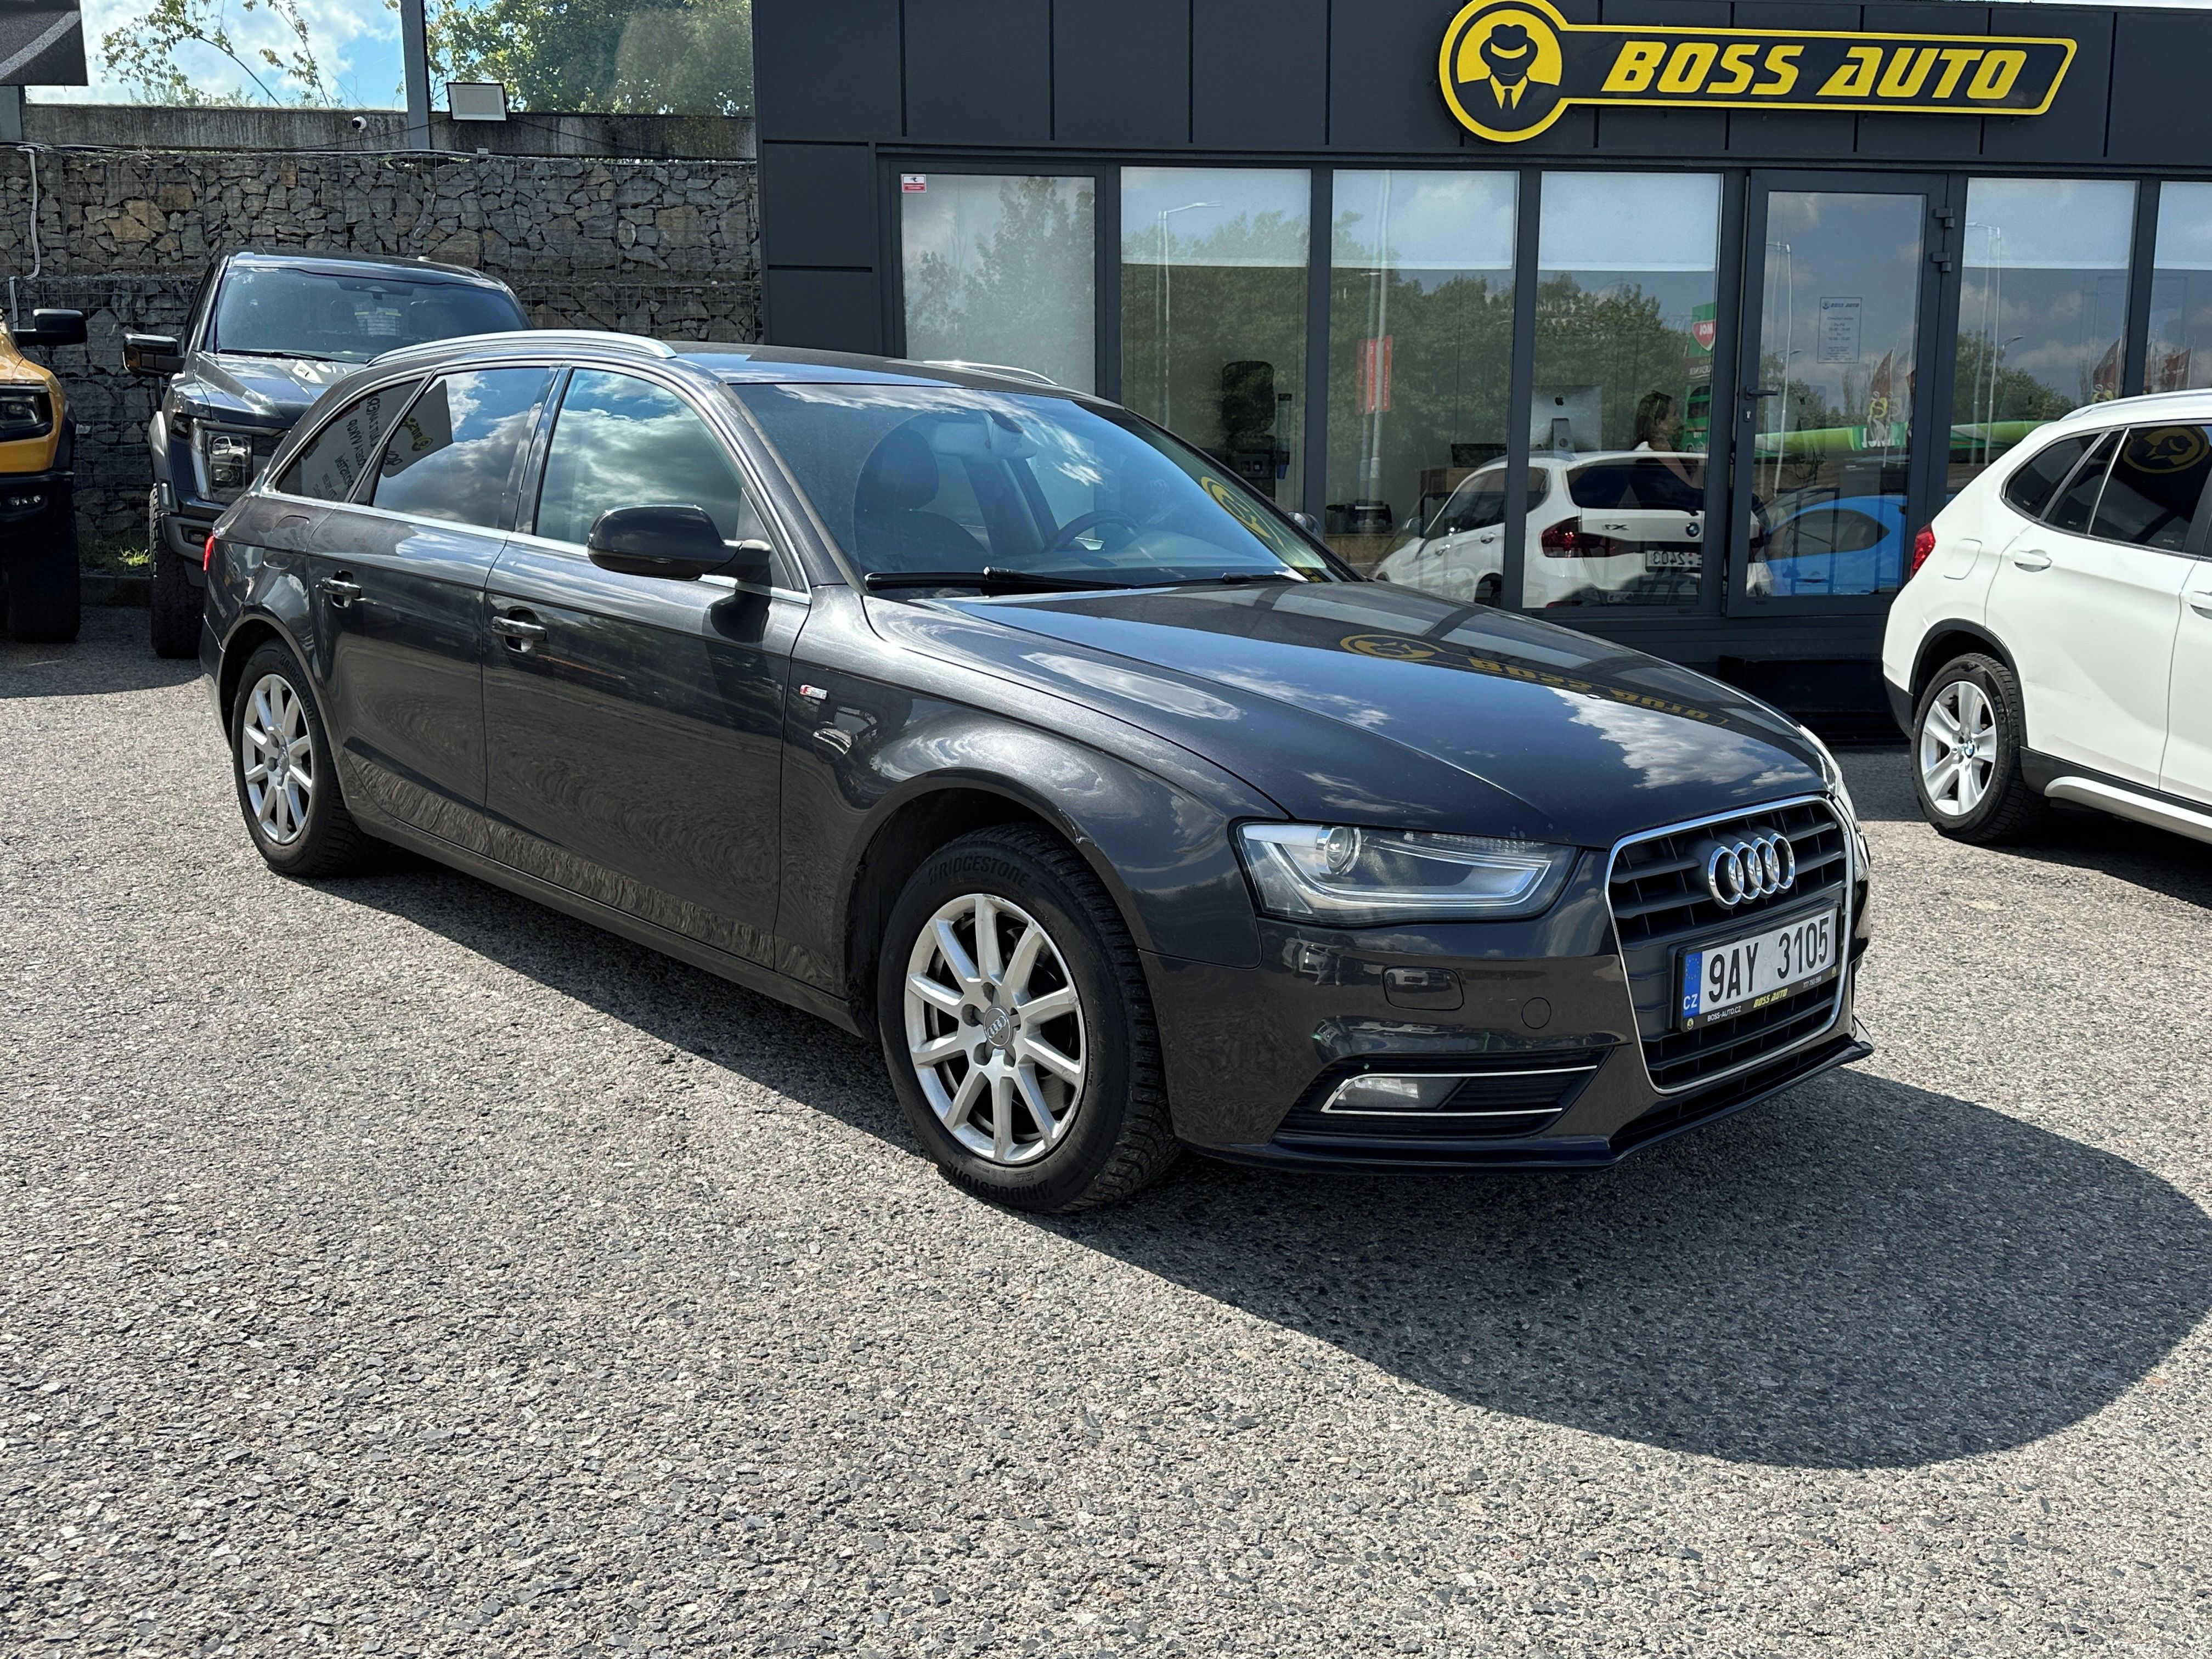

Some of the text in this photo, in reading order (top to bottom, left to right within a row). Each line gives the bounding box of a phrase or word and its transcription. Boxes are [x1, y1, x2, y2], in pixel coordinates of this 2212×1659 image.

[1601, 40, 2028, 100] BOSS AUTO
[928, 855, 1032, 888] BRIDGESTONE
[1708, 916, 1830, 1003] 9AY 3105
[1683, 993, 1699, 1011] CZ
[1707, 988, 1788, 1023] BOSS-AUTO.CZ BOSS AUTO
